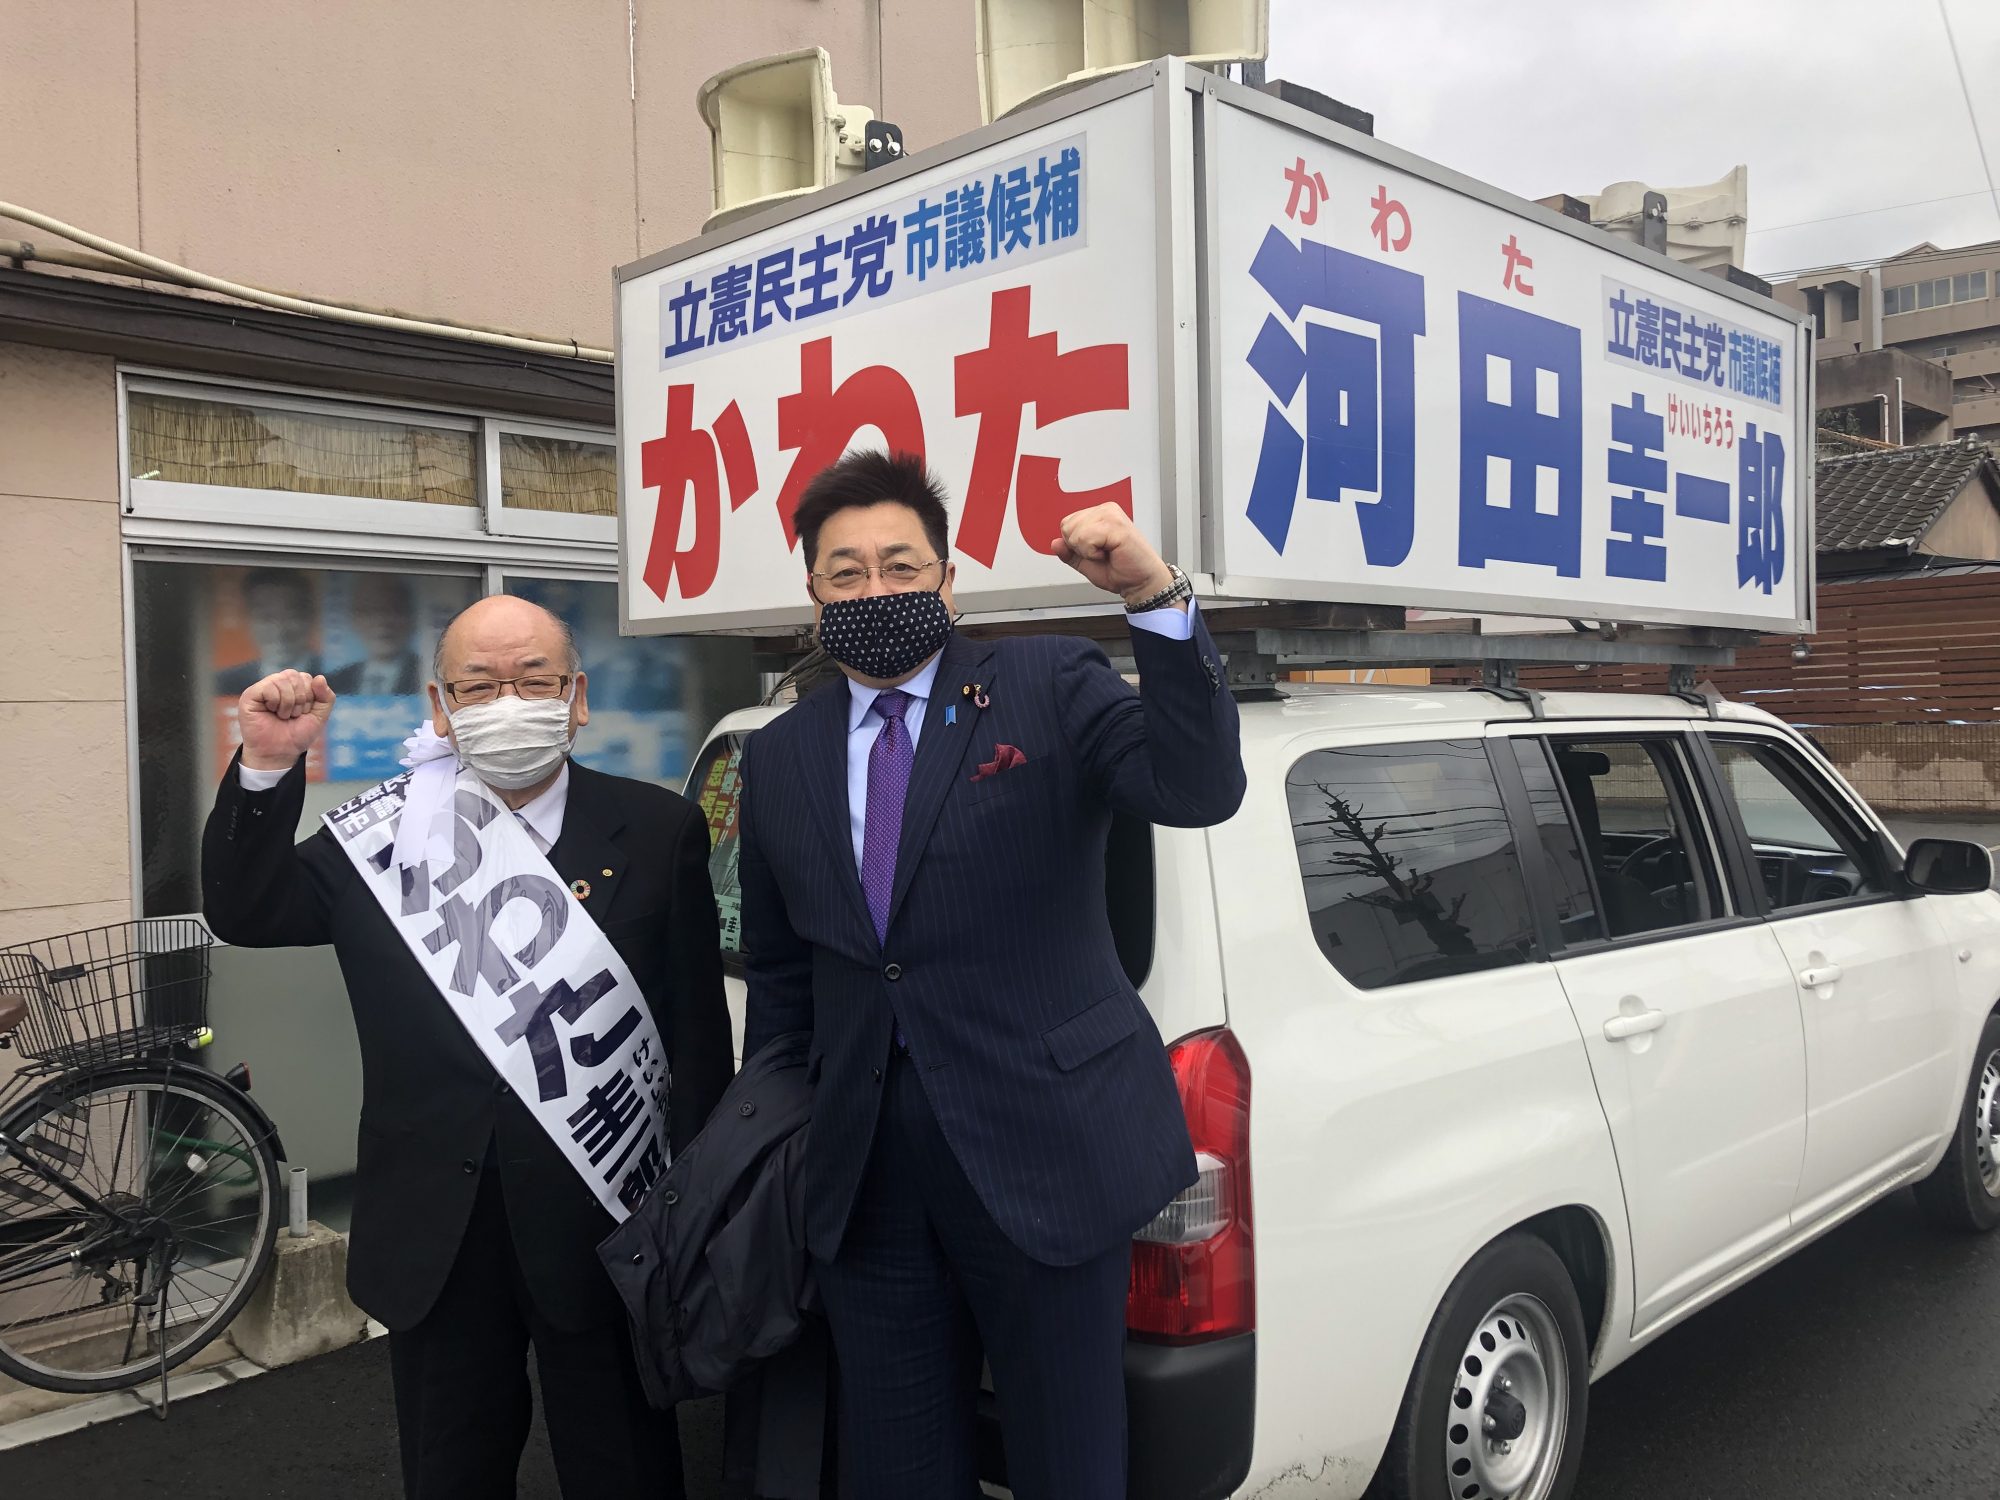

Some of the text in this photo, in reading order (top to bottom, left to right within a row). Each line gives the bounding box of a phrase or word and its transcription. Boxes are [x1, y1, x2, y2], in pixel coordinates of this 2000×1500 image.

[664, 147, 1081, 358] 立憲民主党 市議候補
[1284, 157, 1535, 296] かわた
[641, 285, 1134, 602] かわた
[1246, 224, 1785, 595] 河田 圭一郎
[1608, 289, 1781, 406] 立憲民主党 市議候補
[1668, 393, 1734, 449] けいいちろう
[366, 789, 642, 1102] かわた
